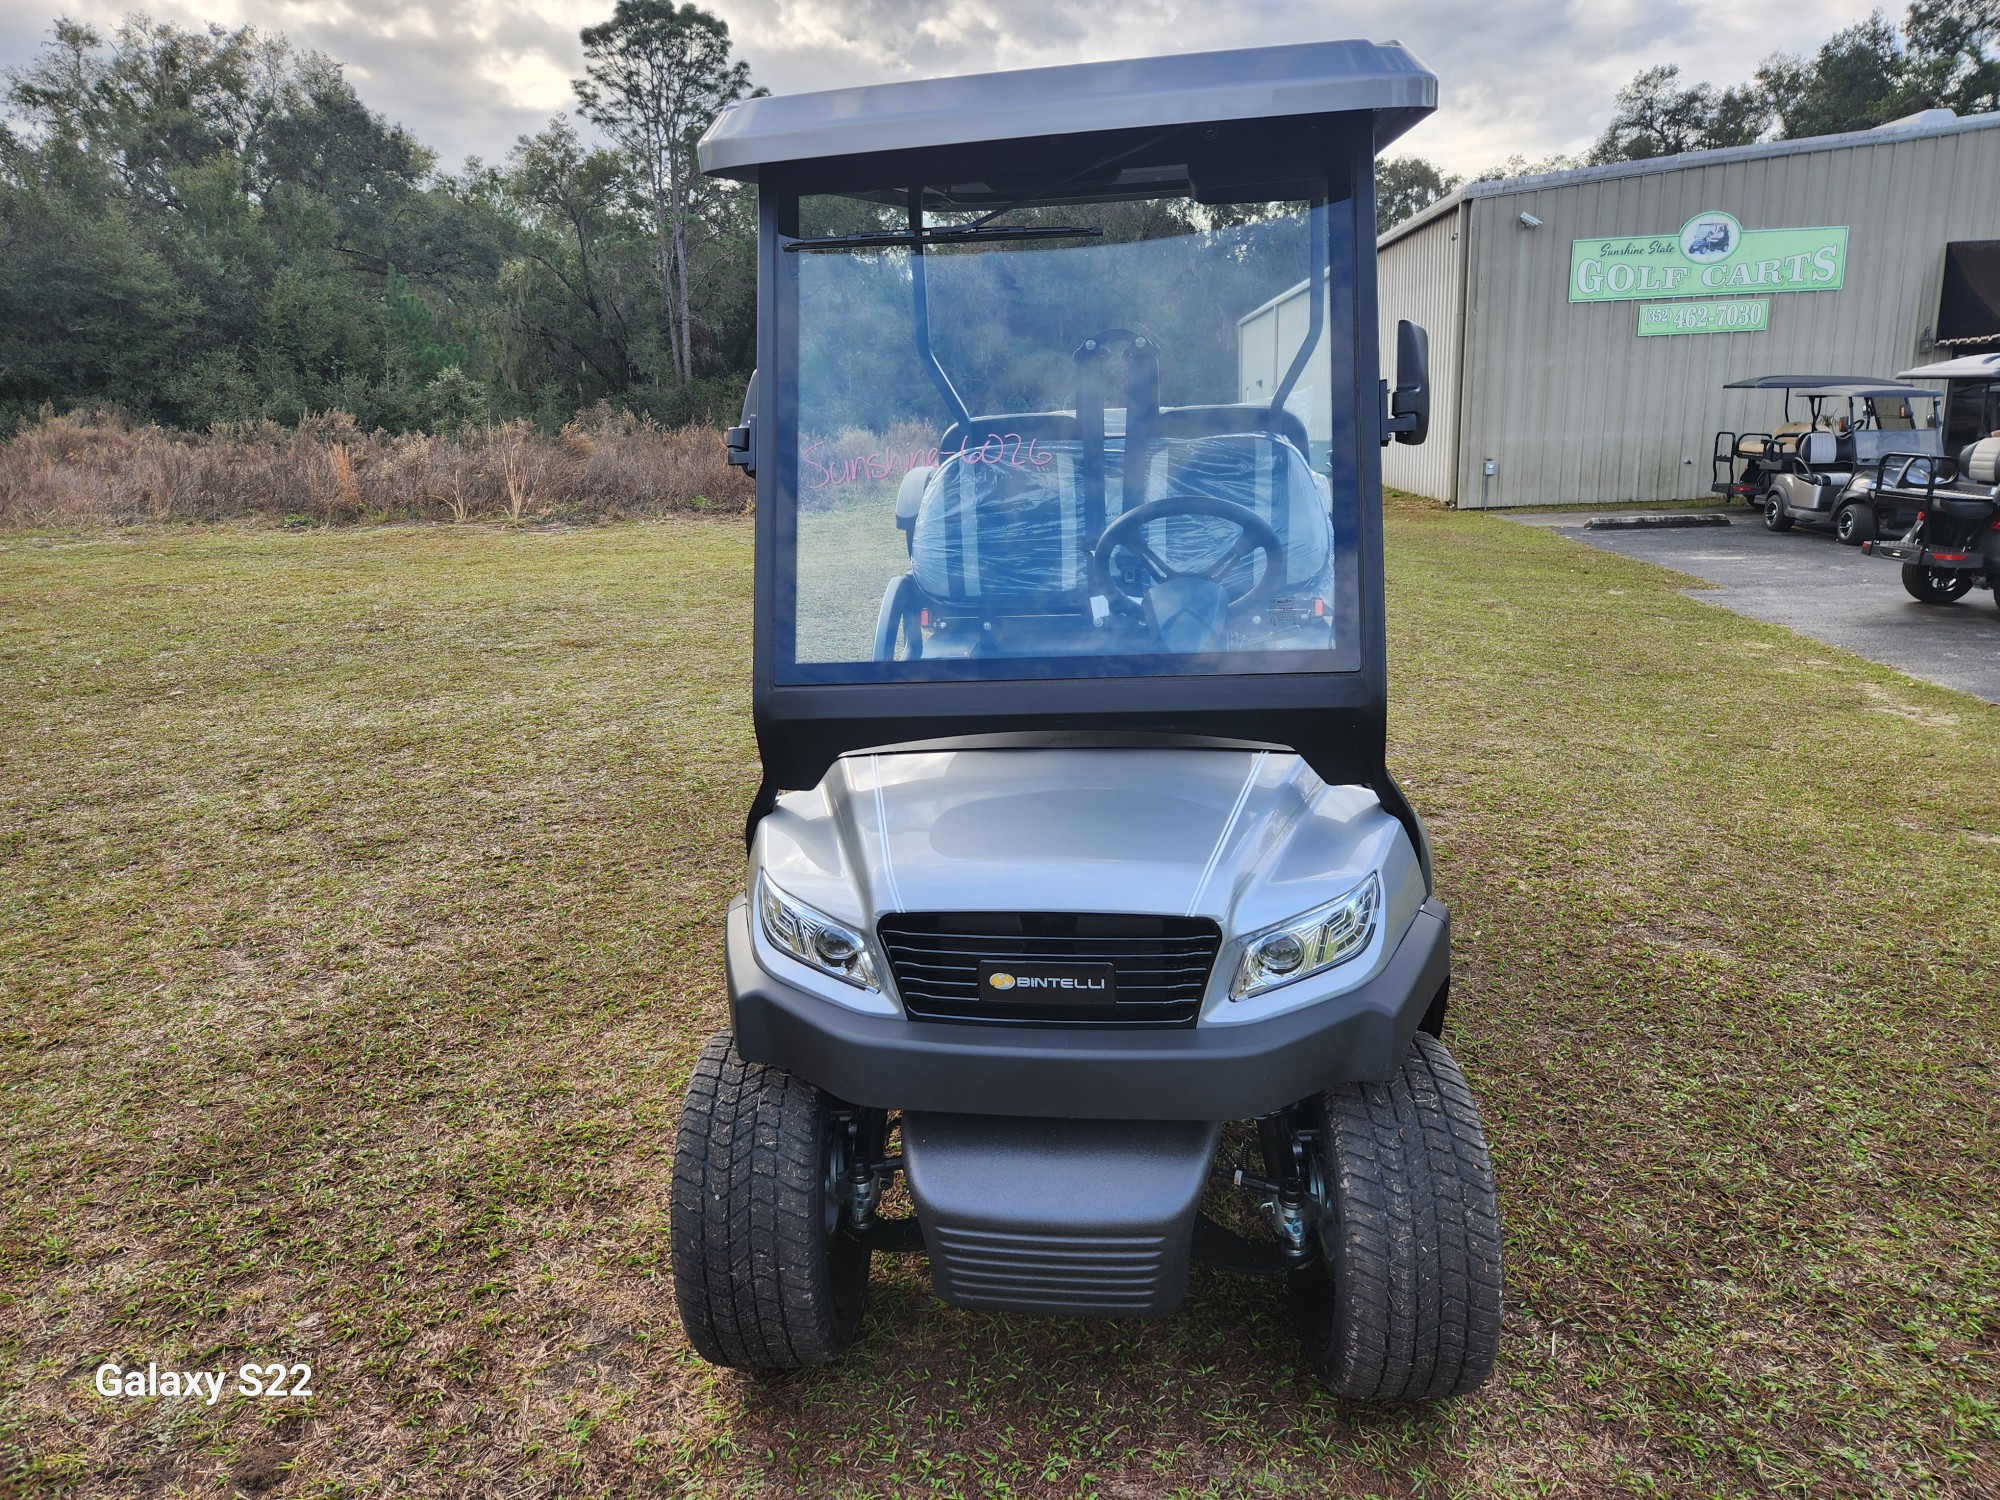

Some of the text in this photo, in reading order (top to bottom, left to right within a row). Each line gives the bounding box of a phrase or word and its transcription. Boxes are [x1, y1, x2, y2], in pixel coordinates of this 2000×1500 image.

[1600, 240, 1675, 257] Sunshine State
[1577, 244, 1837, 294] GOLF CARTS
[1644, 303, 1762, 329] (352) 462-7030
[1016, 976, 1105, 989] BINTELLI
